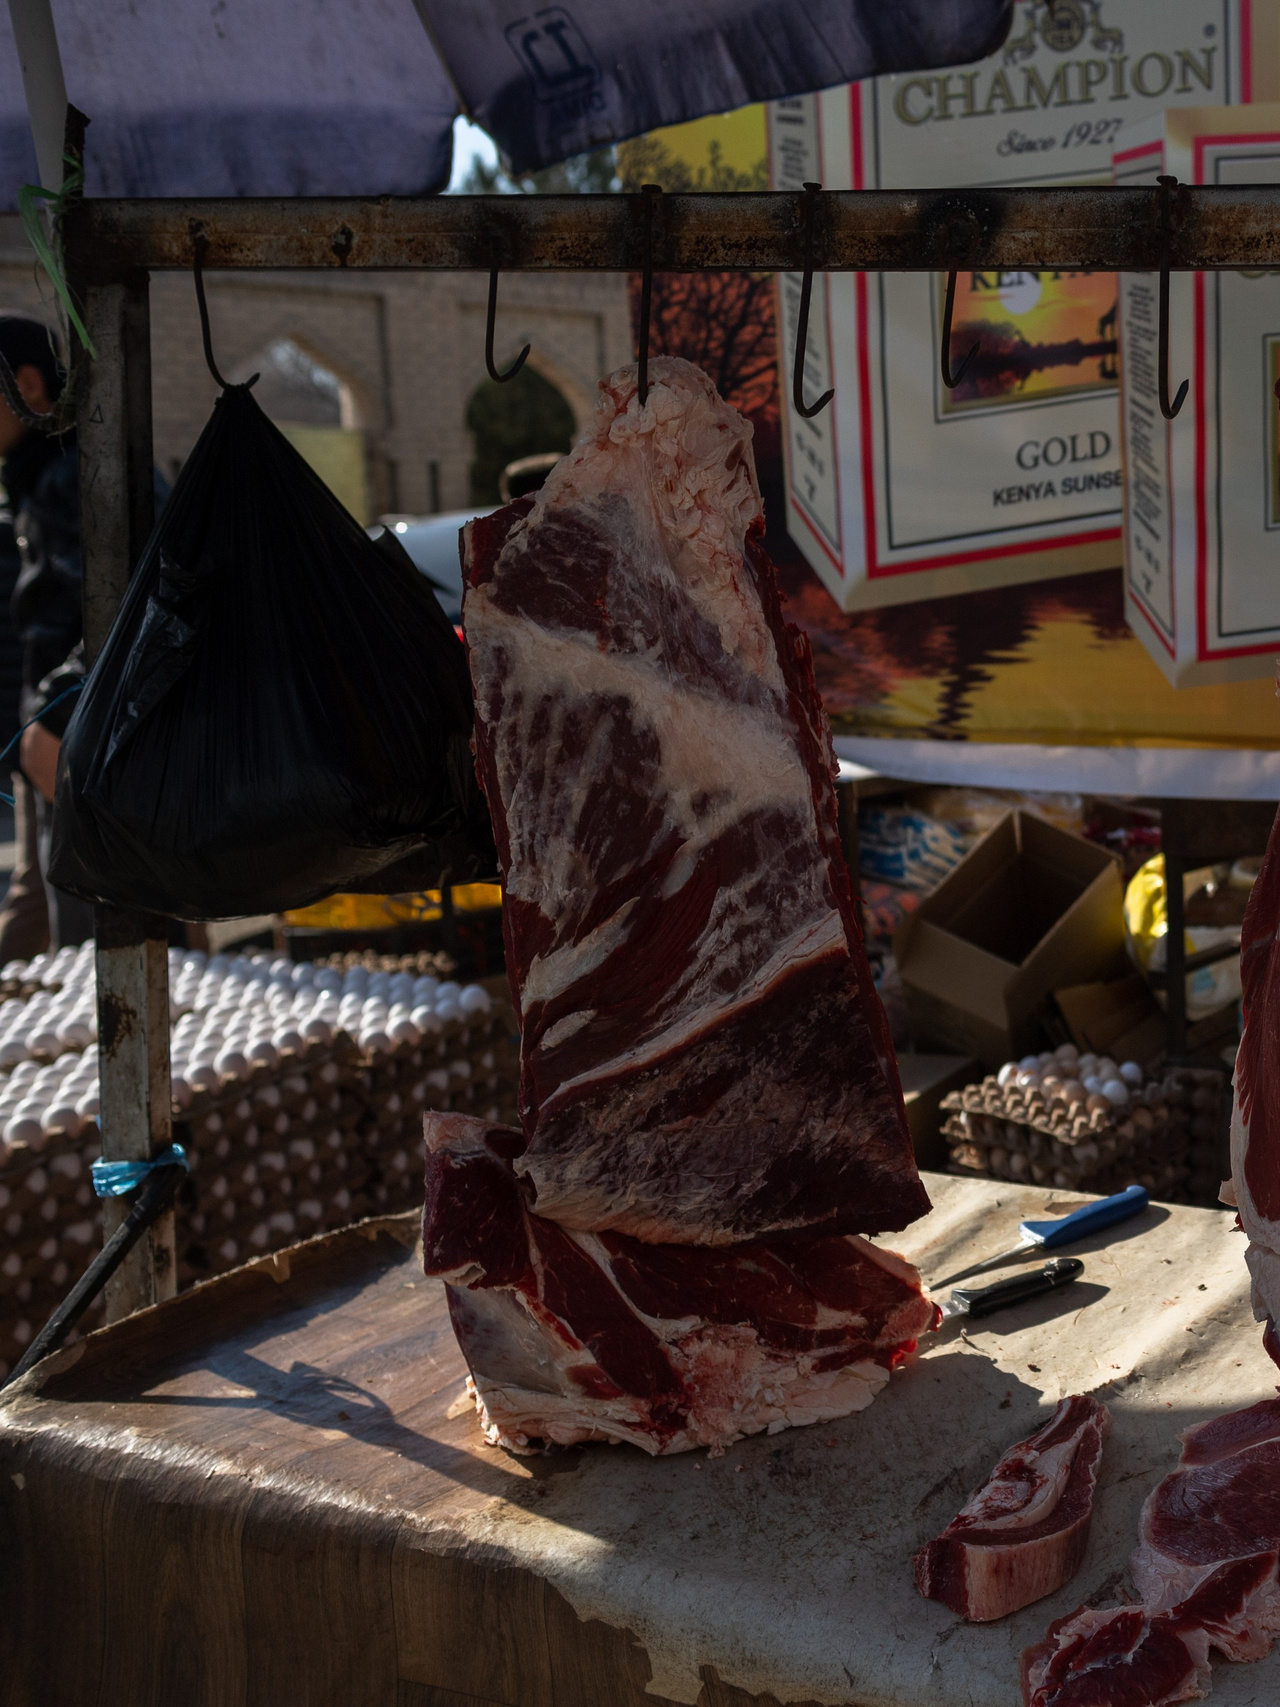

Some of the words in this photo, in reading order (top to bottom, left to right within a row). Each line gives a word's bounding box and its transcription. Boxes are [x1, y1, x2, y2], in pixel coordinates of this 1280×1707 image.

[894, 45, 1217, 127] CHAMPION
[996, 129, 1056, 157] Since
[1062, 118, 1123, 150] 1927
[968, 271, 1094, 292] KEN
[1015, 430, 1112, 472] GOLD
[993, 480, 1056, 507] KENYA
[1061, 469, 1123, 495] SUNSE
